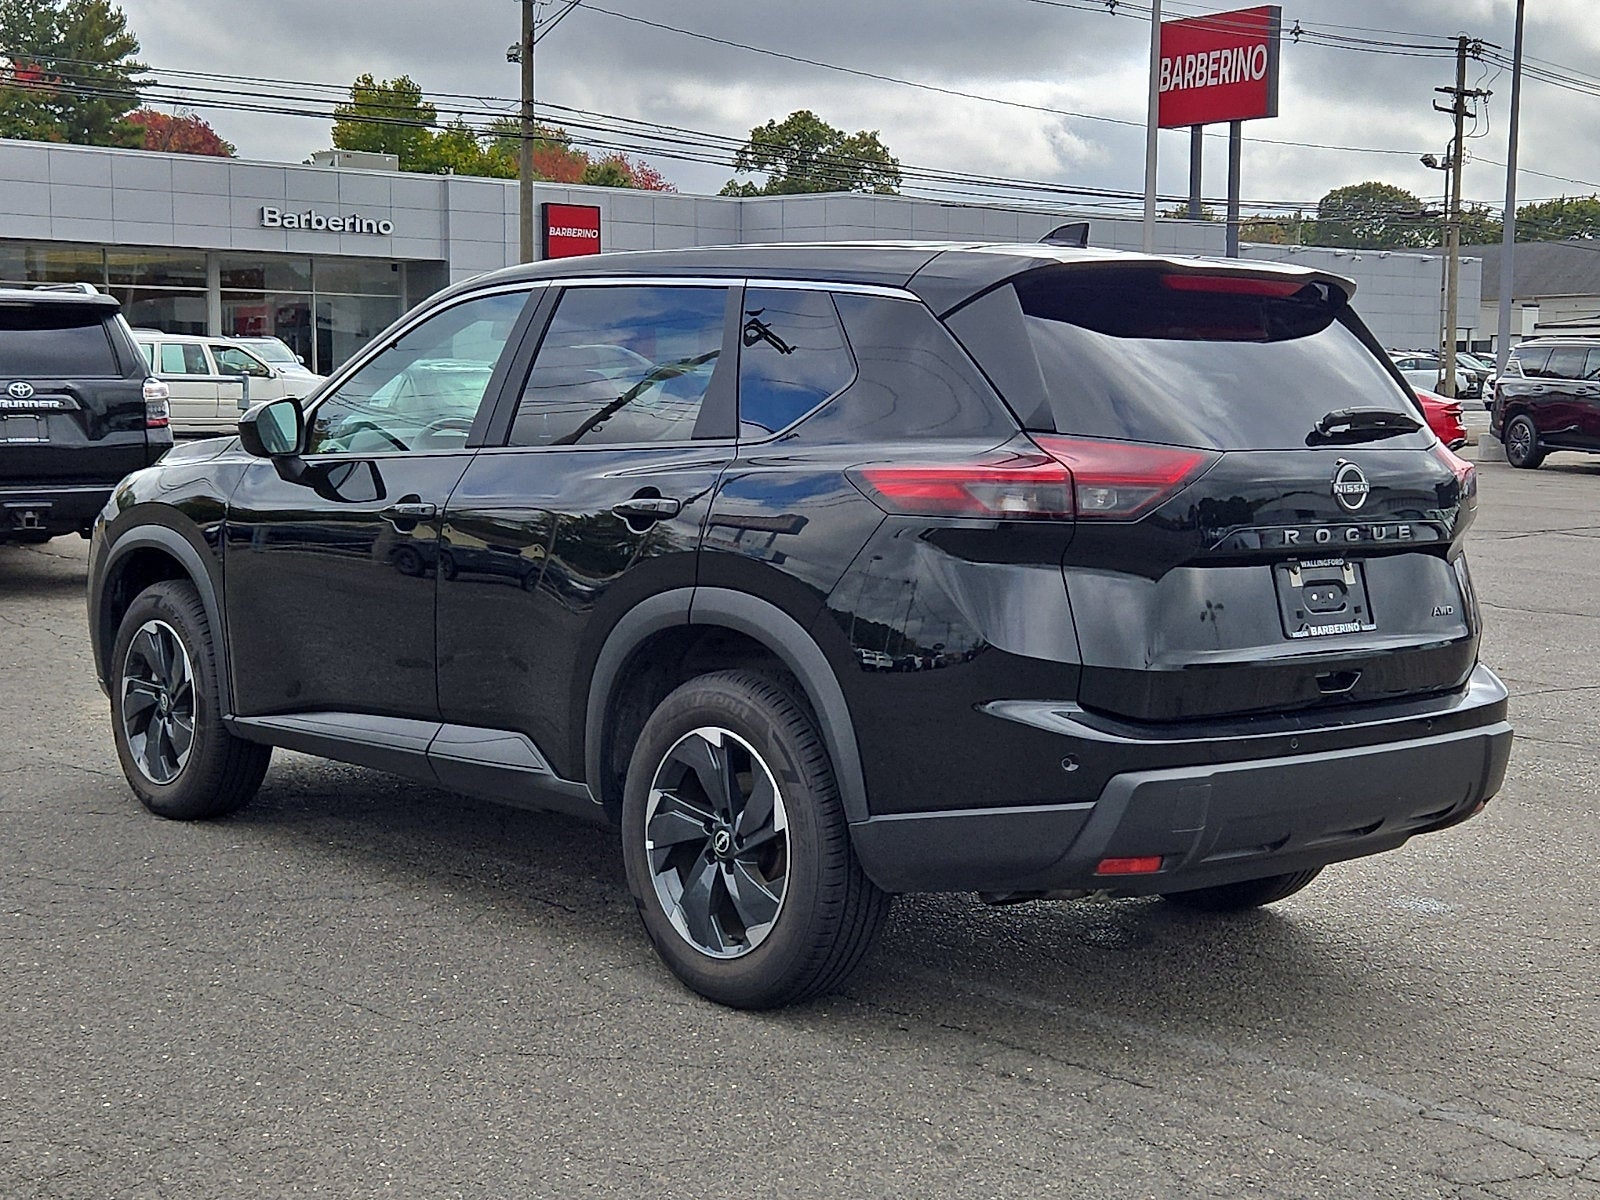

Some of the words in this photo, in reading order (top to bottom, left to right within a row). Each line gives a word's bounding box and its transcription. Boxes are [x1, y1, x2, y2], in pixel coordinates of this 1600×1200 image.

[1159, 43, 1268, 93] BARBERINO
[262, 206, 394, 236] Barberino
[548, 226, 599, 239] BARBERINO
[1335, 483, 1369, 494] NISSAN
[1284, 525, 1411, 545] ROGUE
[1299, 557, 1345, 569] WALLINGFORD
[1431, 605, 1454, 617] AWD
[1310, 622, 1361, 637] BARBERINO
